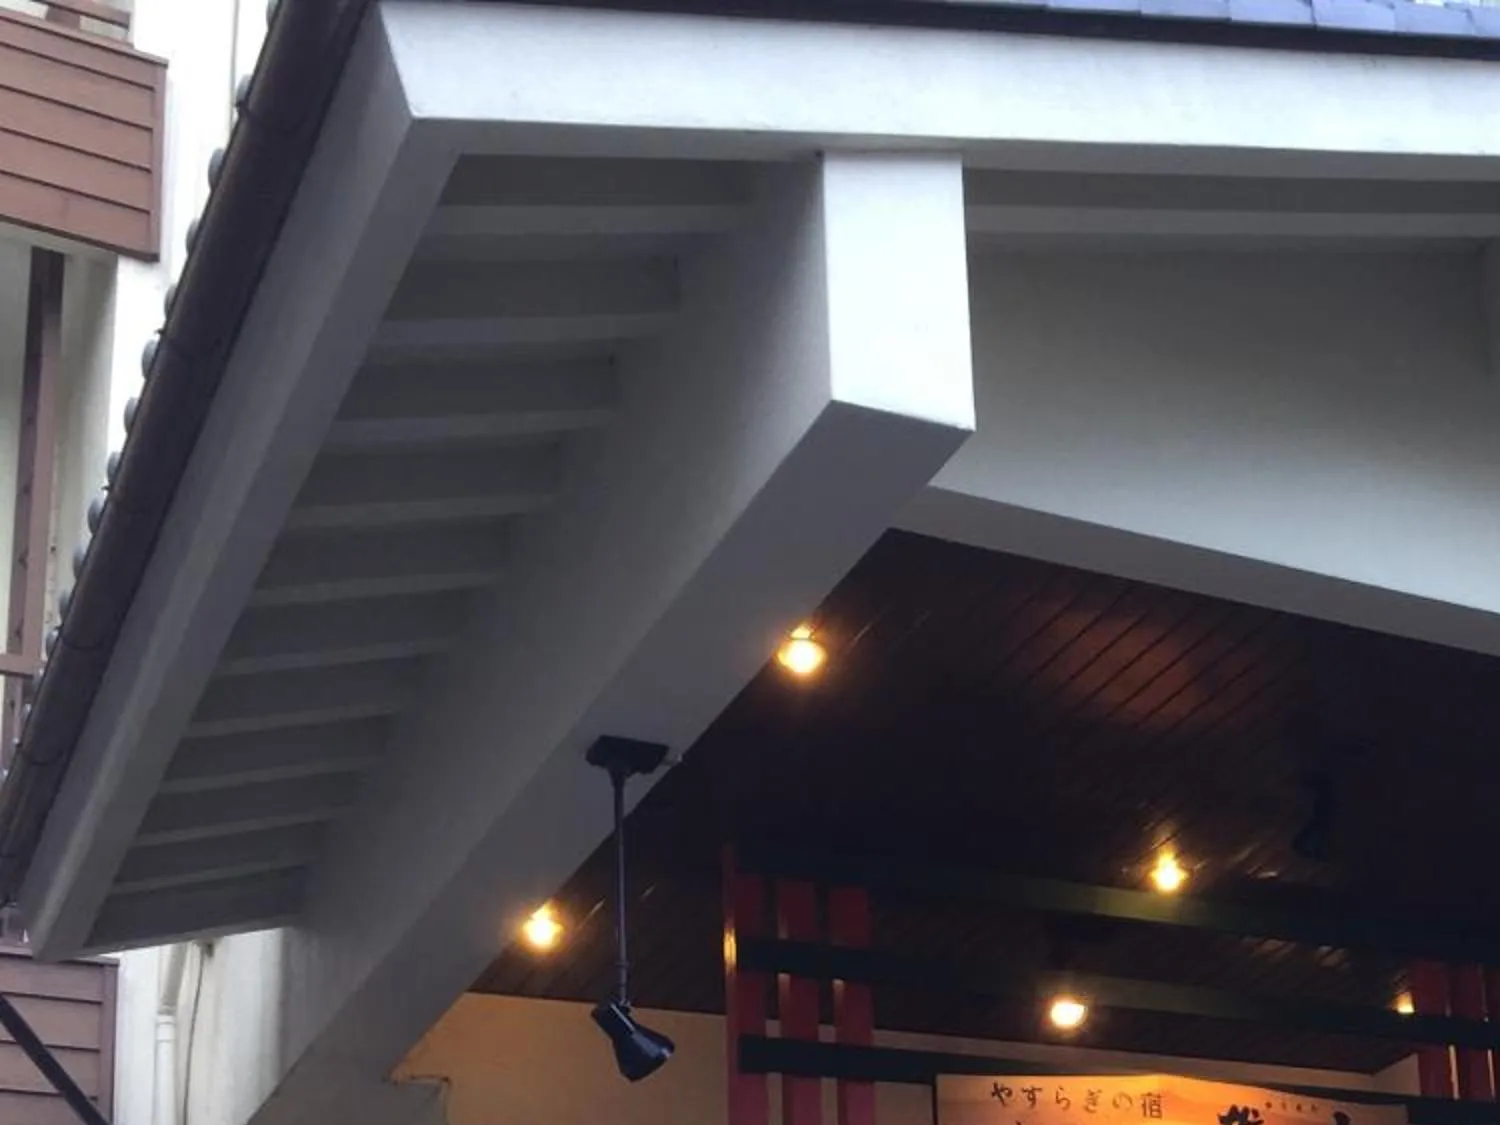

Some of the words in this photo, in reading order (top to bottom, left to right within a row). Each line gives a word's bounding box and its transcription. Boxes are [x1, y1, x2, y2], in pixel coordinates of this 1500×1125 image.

[991, 1081, 1163, 1119] やすらぎの宿
